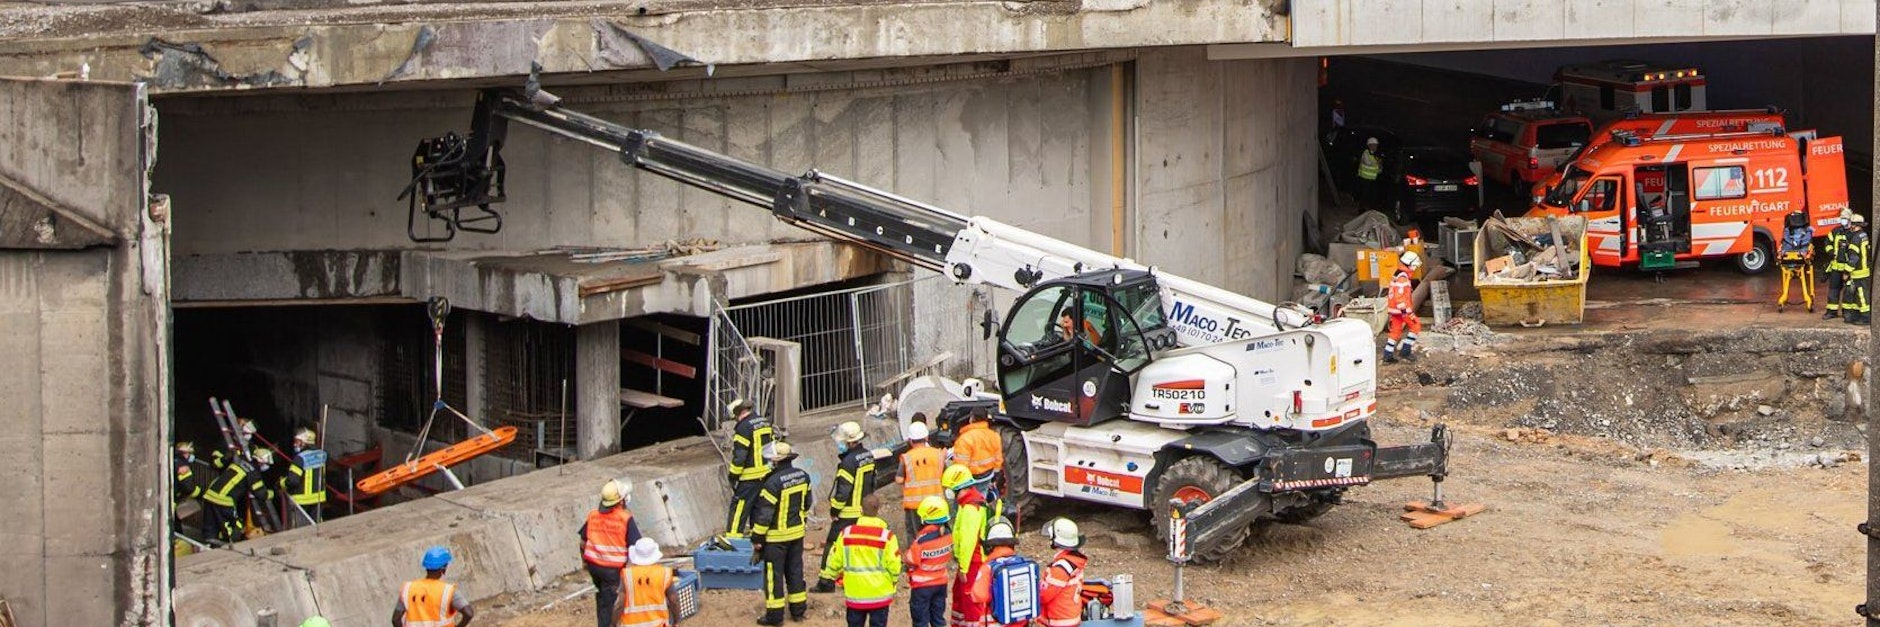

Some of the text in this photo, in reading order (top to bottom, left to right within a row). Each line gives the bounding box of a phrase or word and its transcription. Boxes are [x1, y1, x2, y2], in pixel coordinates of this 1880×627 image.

[1709, 140, 1785, 152] SPEZIALRETTUNG
[1812, 144, 1843, 155] FEUER
[1756, 168, 1788, 187] 112
[820, 208, 942, 253] A B C D E
[1153, 389, 1205, 399] TR50210
[1044, 398, 1072, 413] Bobcat
[1179, 403, 1205, 414] EVO
